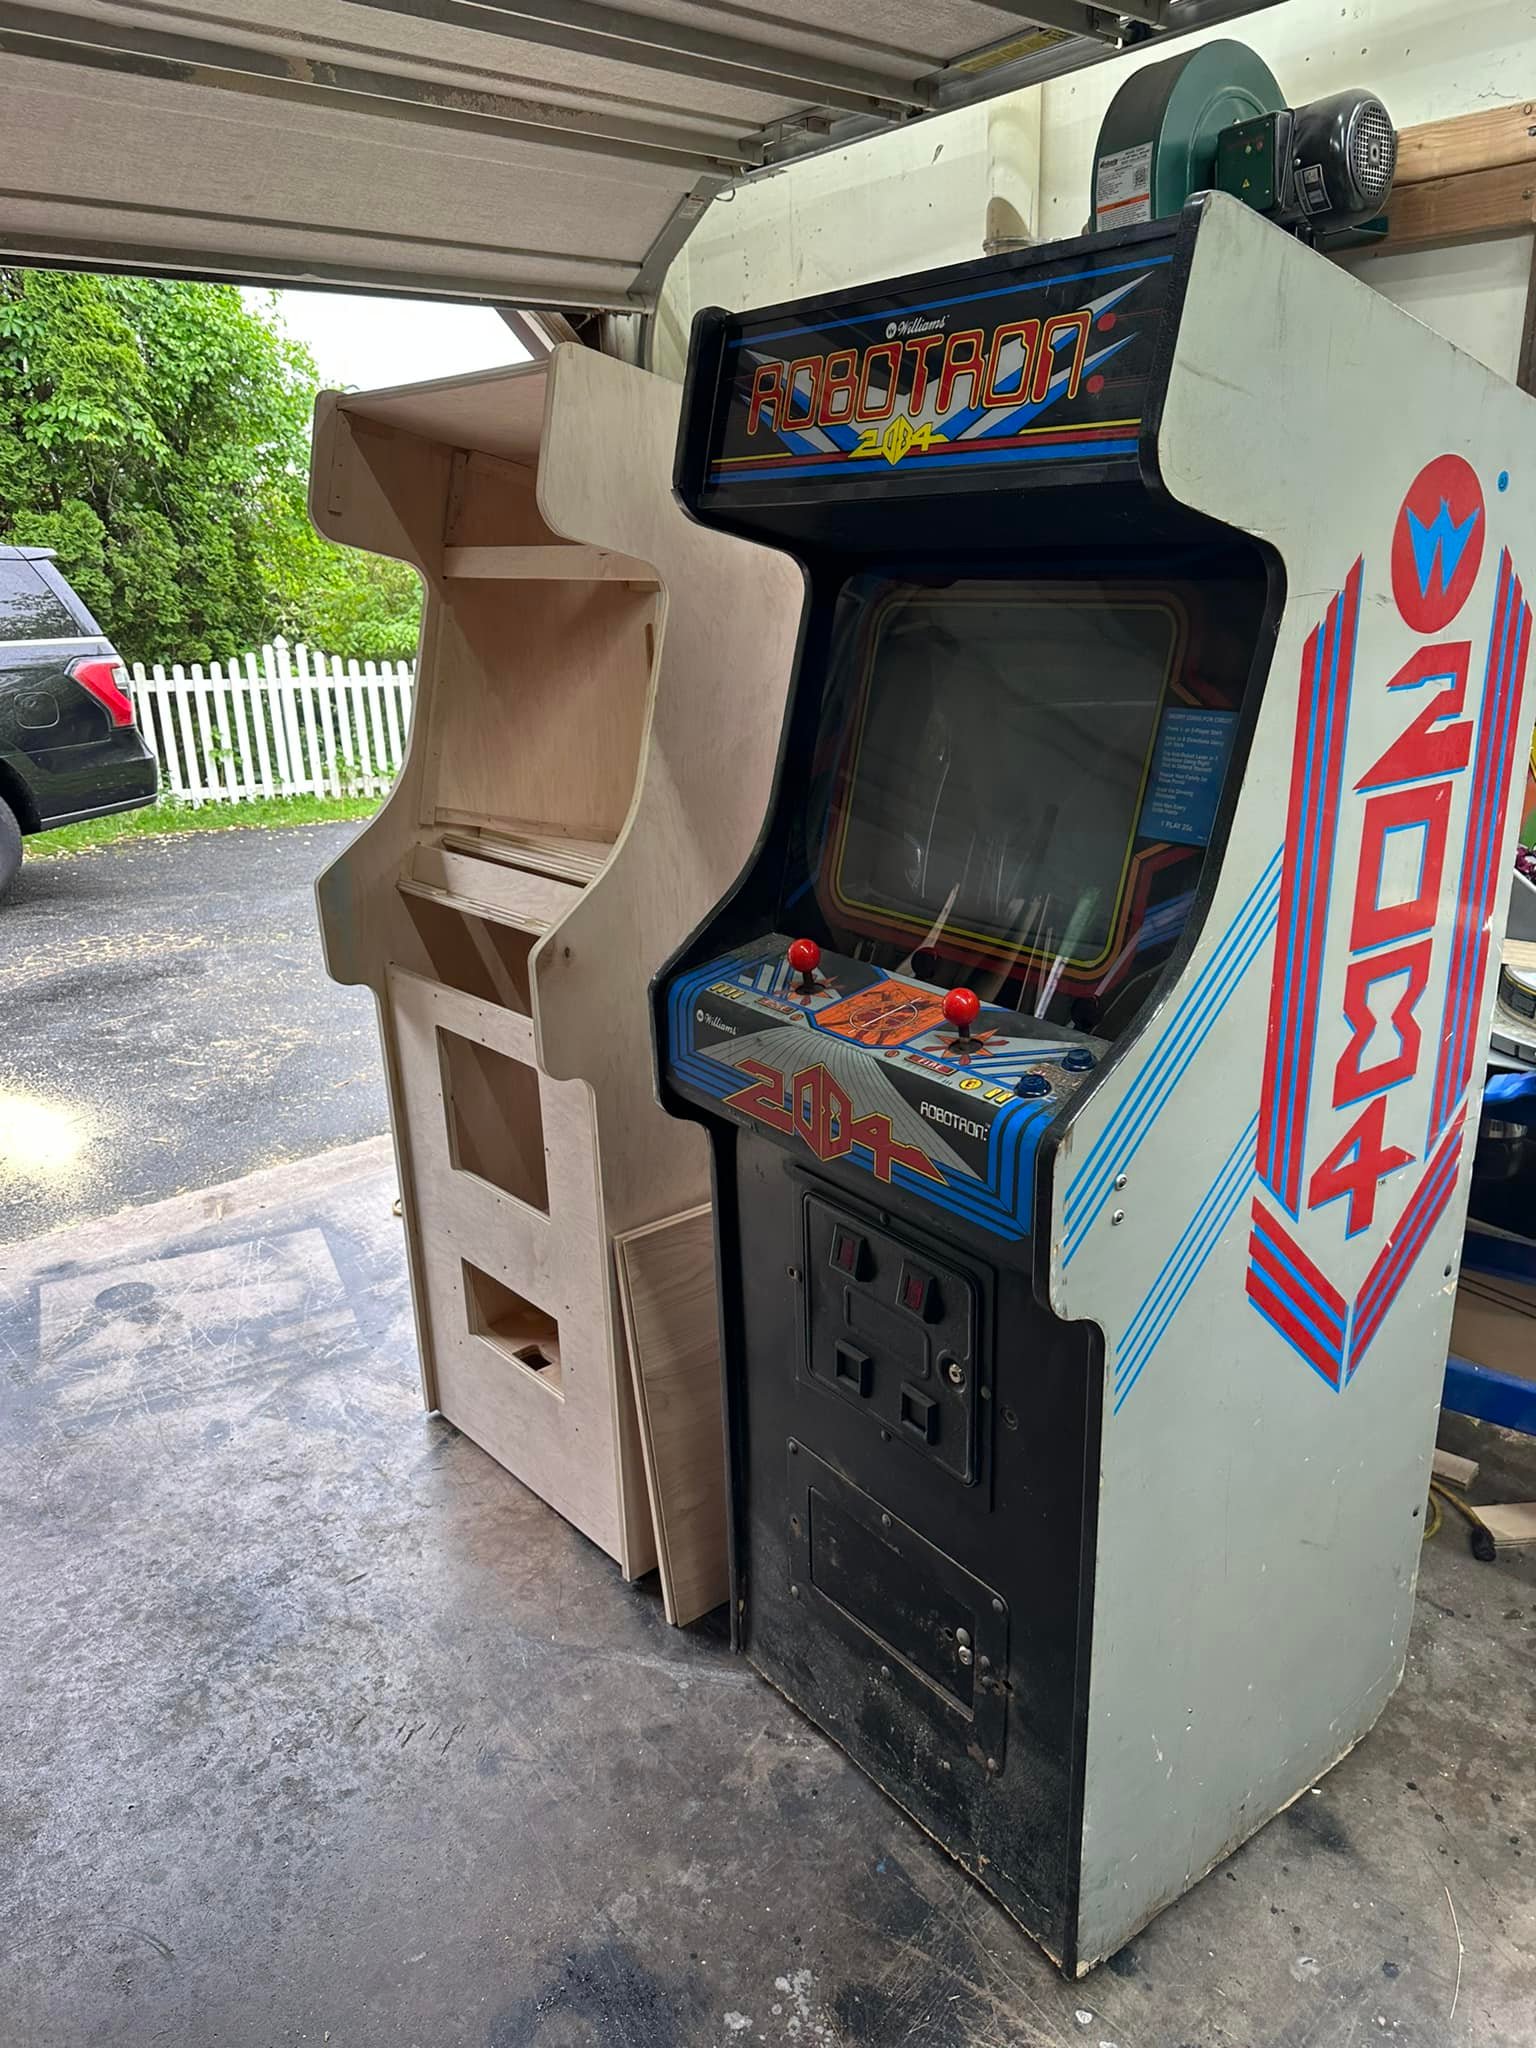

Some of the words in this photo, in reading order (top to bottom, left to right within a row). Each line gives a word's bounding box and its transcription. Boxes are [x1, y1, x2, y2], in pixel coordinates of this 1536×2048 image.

[897, 316, 946, 336] Williams
[747, 310, 1092, 436] ROBOTRON
[848, 414, 950, 465] 2084
[704, 1013, 737, 1036] Williams
[723, 1057, 949, 1185] 2084
